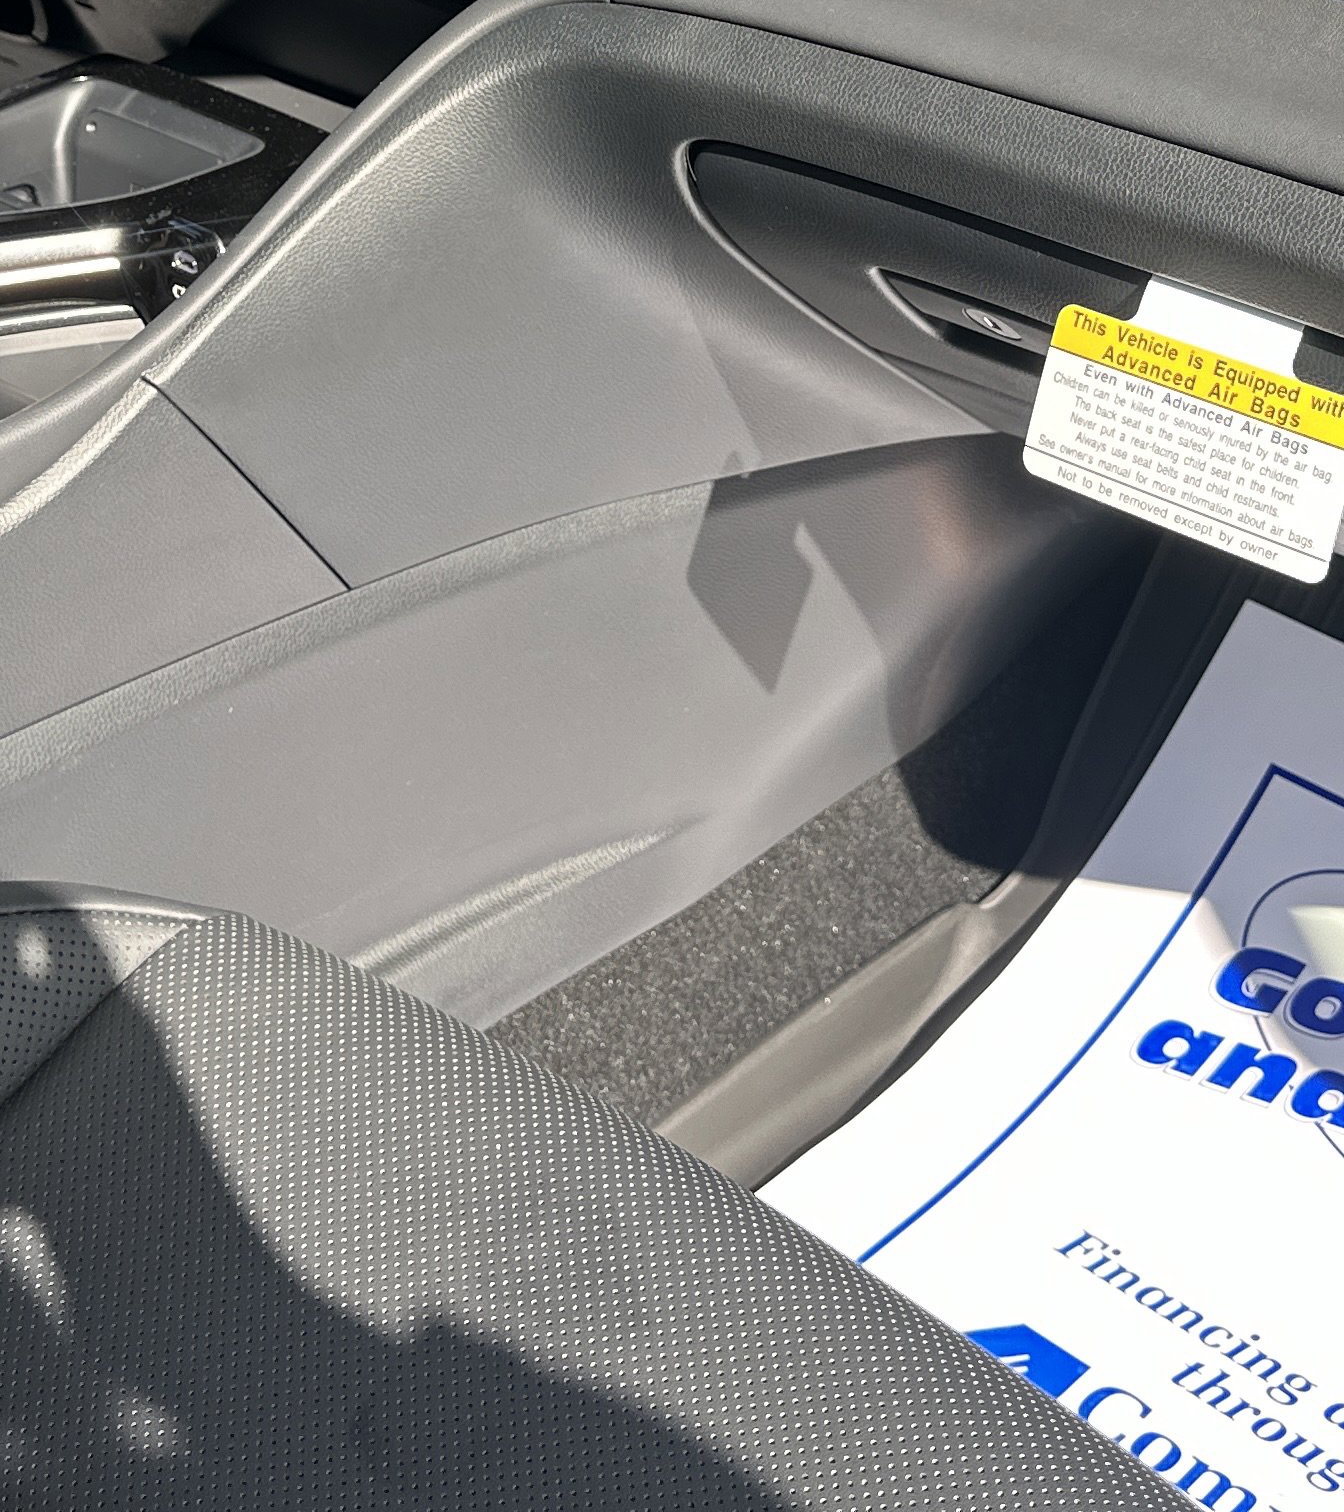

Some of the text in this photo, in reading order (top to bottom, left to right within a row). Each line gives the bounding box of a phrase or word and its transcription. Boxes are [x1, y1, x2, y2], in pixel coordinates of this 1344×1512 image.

[1073, 310, 1107, 336] This
[1117, 325, 1179, 361] Vehicle
[1187, 350, 1204, 370] is
[1213, 359, 1302, 404] Equipped
[1102, 345, 1302, 428] Advanced Air Bags
[1054, 371, 1089, 394] Children
[1094, 388, 1110, 401] can
[1114, 392, 1127, 407] be
[1131, 400, 1155, 418] killed
[1158, 411, 1170, 422] or
[1219, 433, 1252, 454] injured
[1256, 445, 1269, 461] by
[1273, 451, 1289, 466] the
[1294, 460, 1308, 474] air
[1075, 395, 1091, 412] The
[1095, 405, 1118, 421] back
[1121, 415, 1142, 431] seat
[1146, 424, 1154, 434] is
[1158, 427, 1173, 442] the
[1177, 436, 1207, 455] safest
[1210, 447, 1237, 466] place
[1242, 458, 1255, 473] for
[1084, 364, 1309, 455] Even with Advanced Air Bags
[1038, 433, 1056, 450] See
[1098, 458, 1132, 478] manual
[1135, 472, 1149, 486] for
[1151, 480, 1176, 496] more
[1181, 488, 1233, 518] information
[1237, 512, 1266, 531] about
[1269, 524, 1285, 537] air
[1070, 411, 1295, 506] Never put a rear-facing child seat in the front.
[1075, 431, 1280, 518] Always use seat belts and child restraints.
[1057, 465, 1278, 561] Not to be removed except by owner
[1052, 1228, 1318, 1406] Financing
